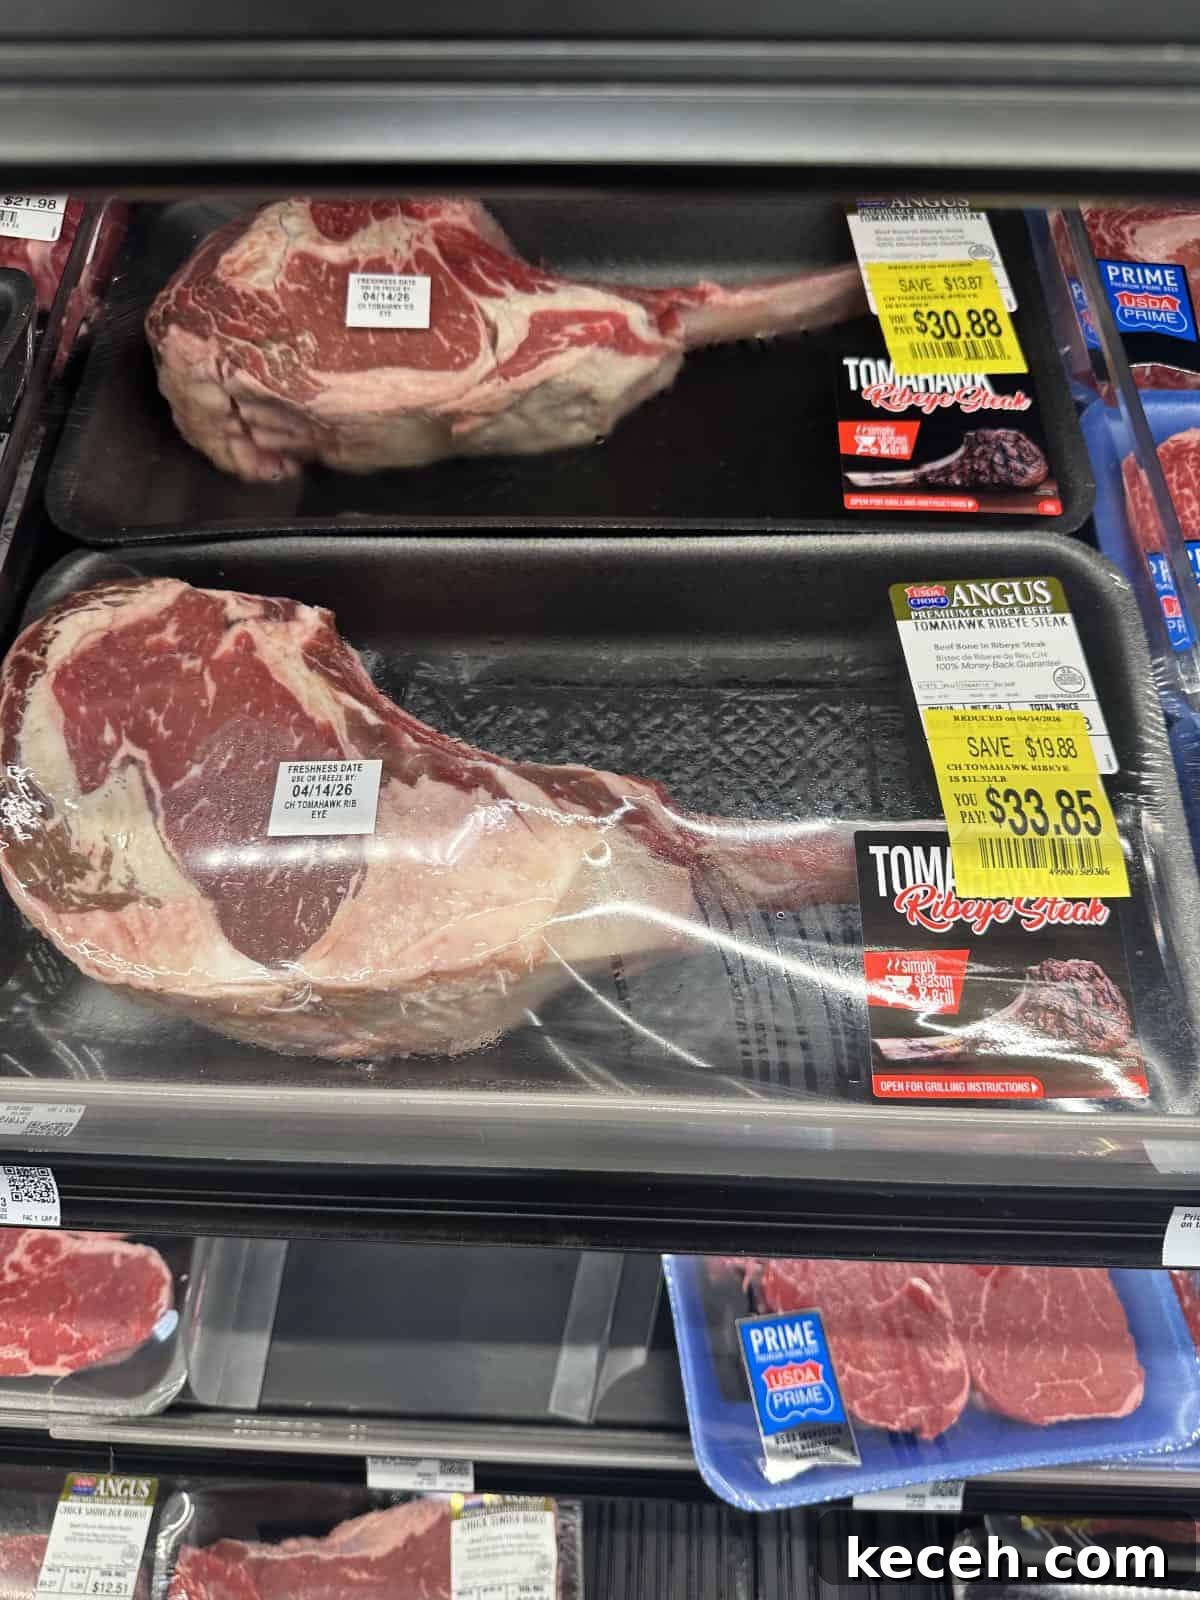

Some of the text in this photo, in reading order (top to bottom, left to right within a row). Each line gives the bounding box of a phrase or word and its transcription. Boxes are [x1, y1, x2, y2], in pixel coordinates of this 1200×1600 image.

[4, 196, 57, 209] $21.98
[1106, 265, 1178, 287] PRIME
[899, 275, 983, 293] SAVE $13.87
[362, 292, 410, 302] 04/14/26
[1123, 295, 1171, 310] USDA
[913, 308, 1003, 340] $30.88
[1123, 309, 1178, 324] PRIME
[861, 382, 1032, 414] Ribeye Steak
[951, 580, 1052, 608] ANGUS
[910, 598, 947, 607] CHOICE
[911, 605, 1054, 620] PREMIUM CHOICE BEEF
[913, 615, 1069, 632] TOMAHAWK RIBEYE STEAK
[936, 662, 959, 671] 100%
[1029, 702, 1081, 711] TOTAL PRICE
[967, 735, 1078, 761] SAVE $19.88
[288, 763, 364, 774] FRESHNESS DATE
[967, 763, 1028, 772] TOMAHAWK
[291, 775, 305, 783] USE
[318, 774, 343, 782] FREEZE
[292, 783, 353, 798] 04/14/26
[284, 799, 358, 810] CH TOMAHAWK RIB
[954, 793, 979, 806] YOU
[311, 810, 328, 819] EYE
[960, 810, 988, 824] PAY!
[985, 785, 1102, 837] $33.85
[893, 883, 1110, 935] Ribeye Steak
[901, 956, 937, 975] simply
[914, 975, 953, 988] season
[932, 989, 955, 1006] grill
[880, 1080, 1031, 1093] OPEN FOR GRILLING INSTRUCTIONS
[750, 1320, 817, 1356] PRIME
[769, 1367, 817, 1387] USDA
[772, 1385, 824, 1409] PRIME
[94, 1477, 151, 1497] ANGUS
[92, 1581, 129, 1594] $12.51
